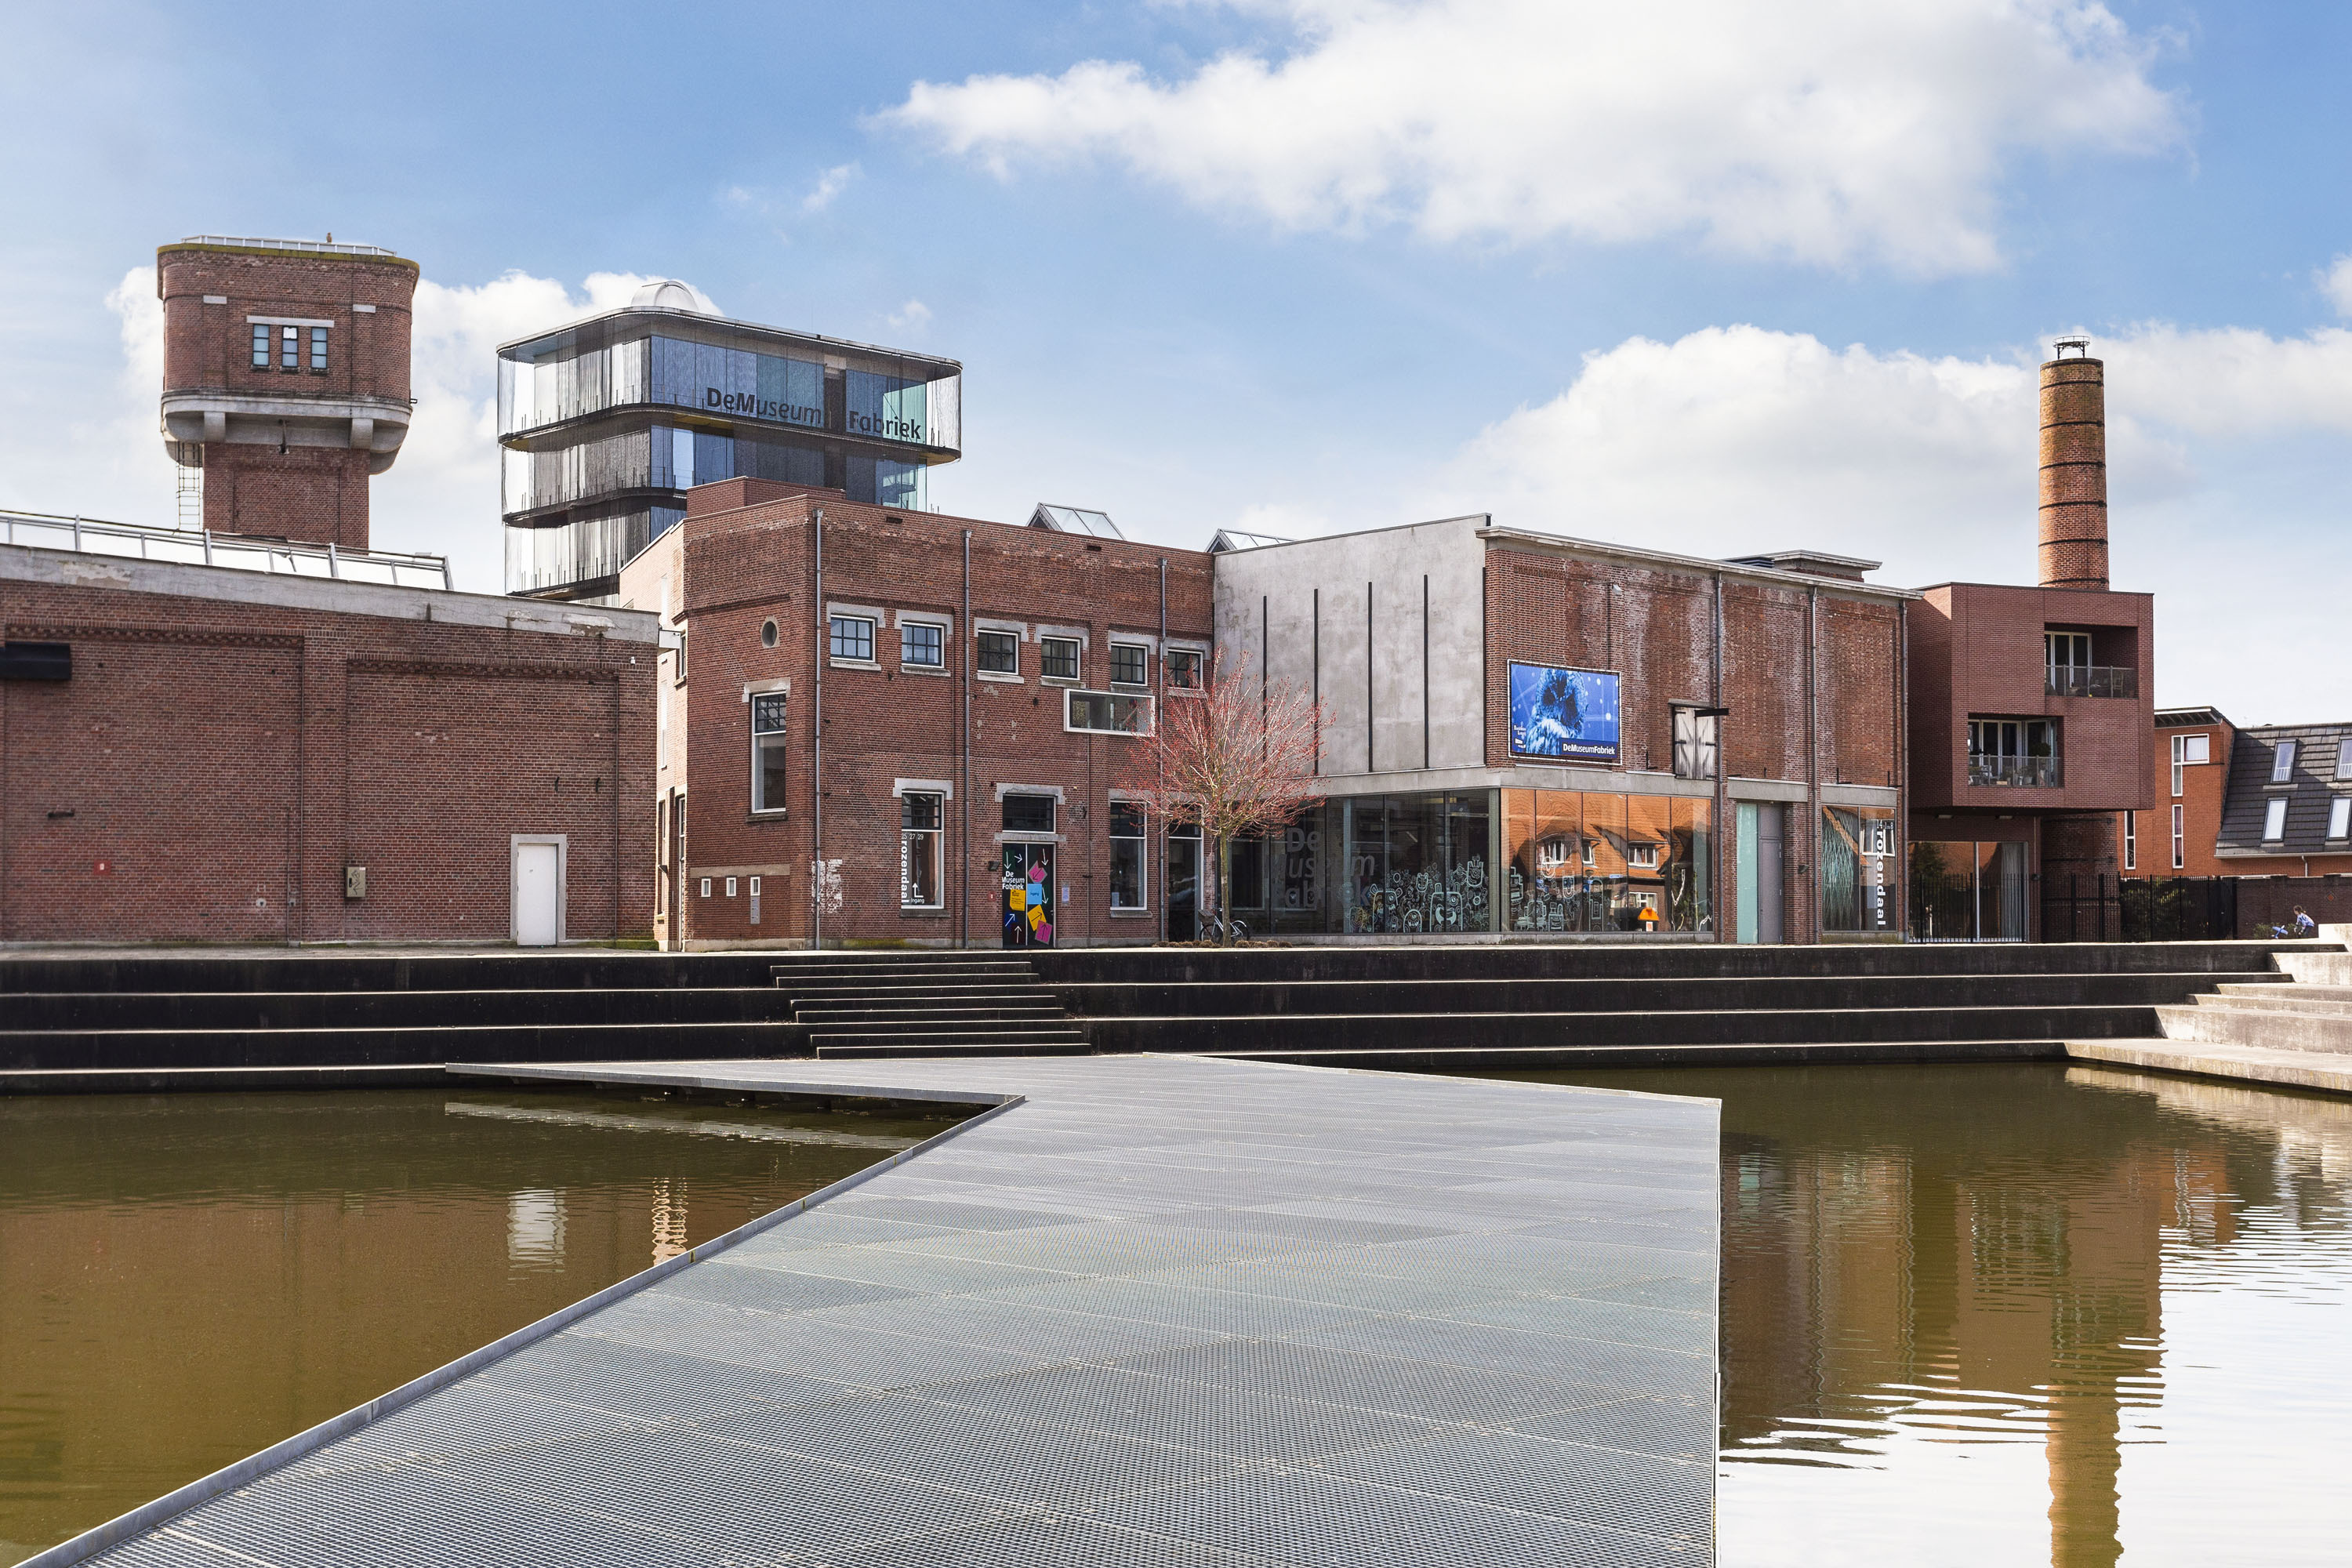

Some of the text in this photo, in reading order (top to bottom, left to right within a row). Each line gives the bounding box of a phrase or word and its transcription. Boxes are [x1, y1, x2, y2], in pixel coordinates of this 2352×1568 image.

[706, 387, 921, 440] DeMuseum Fabriek
[1563, 743, 1615, 755] DeMuseumFabriek
[1287, 826, 1322, 852] De
[901, 840, 909, 902] rozendaal
[1876, 831, 1886, 925] rozendaal
